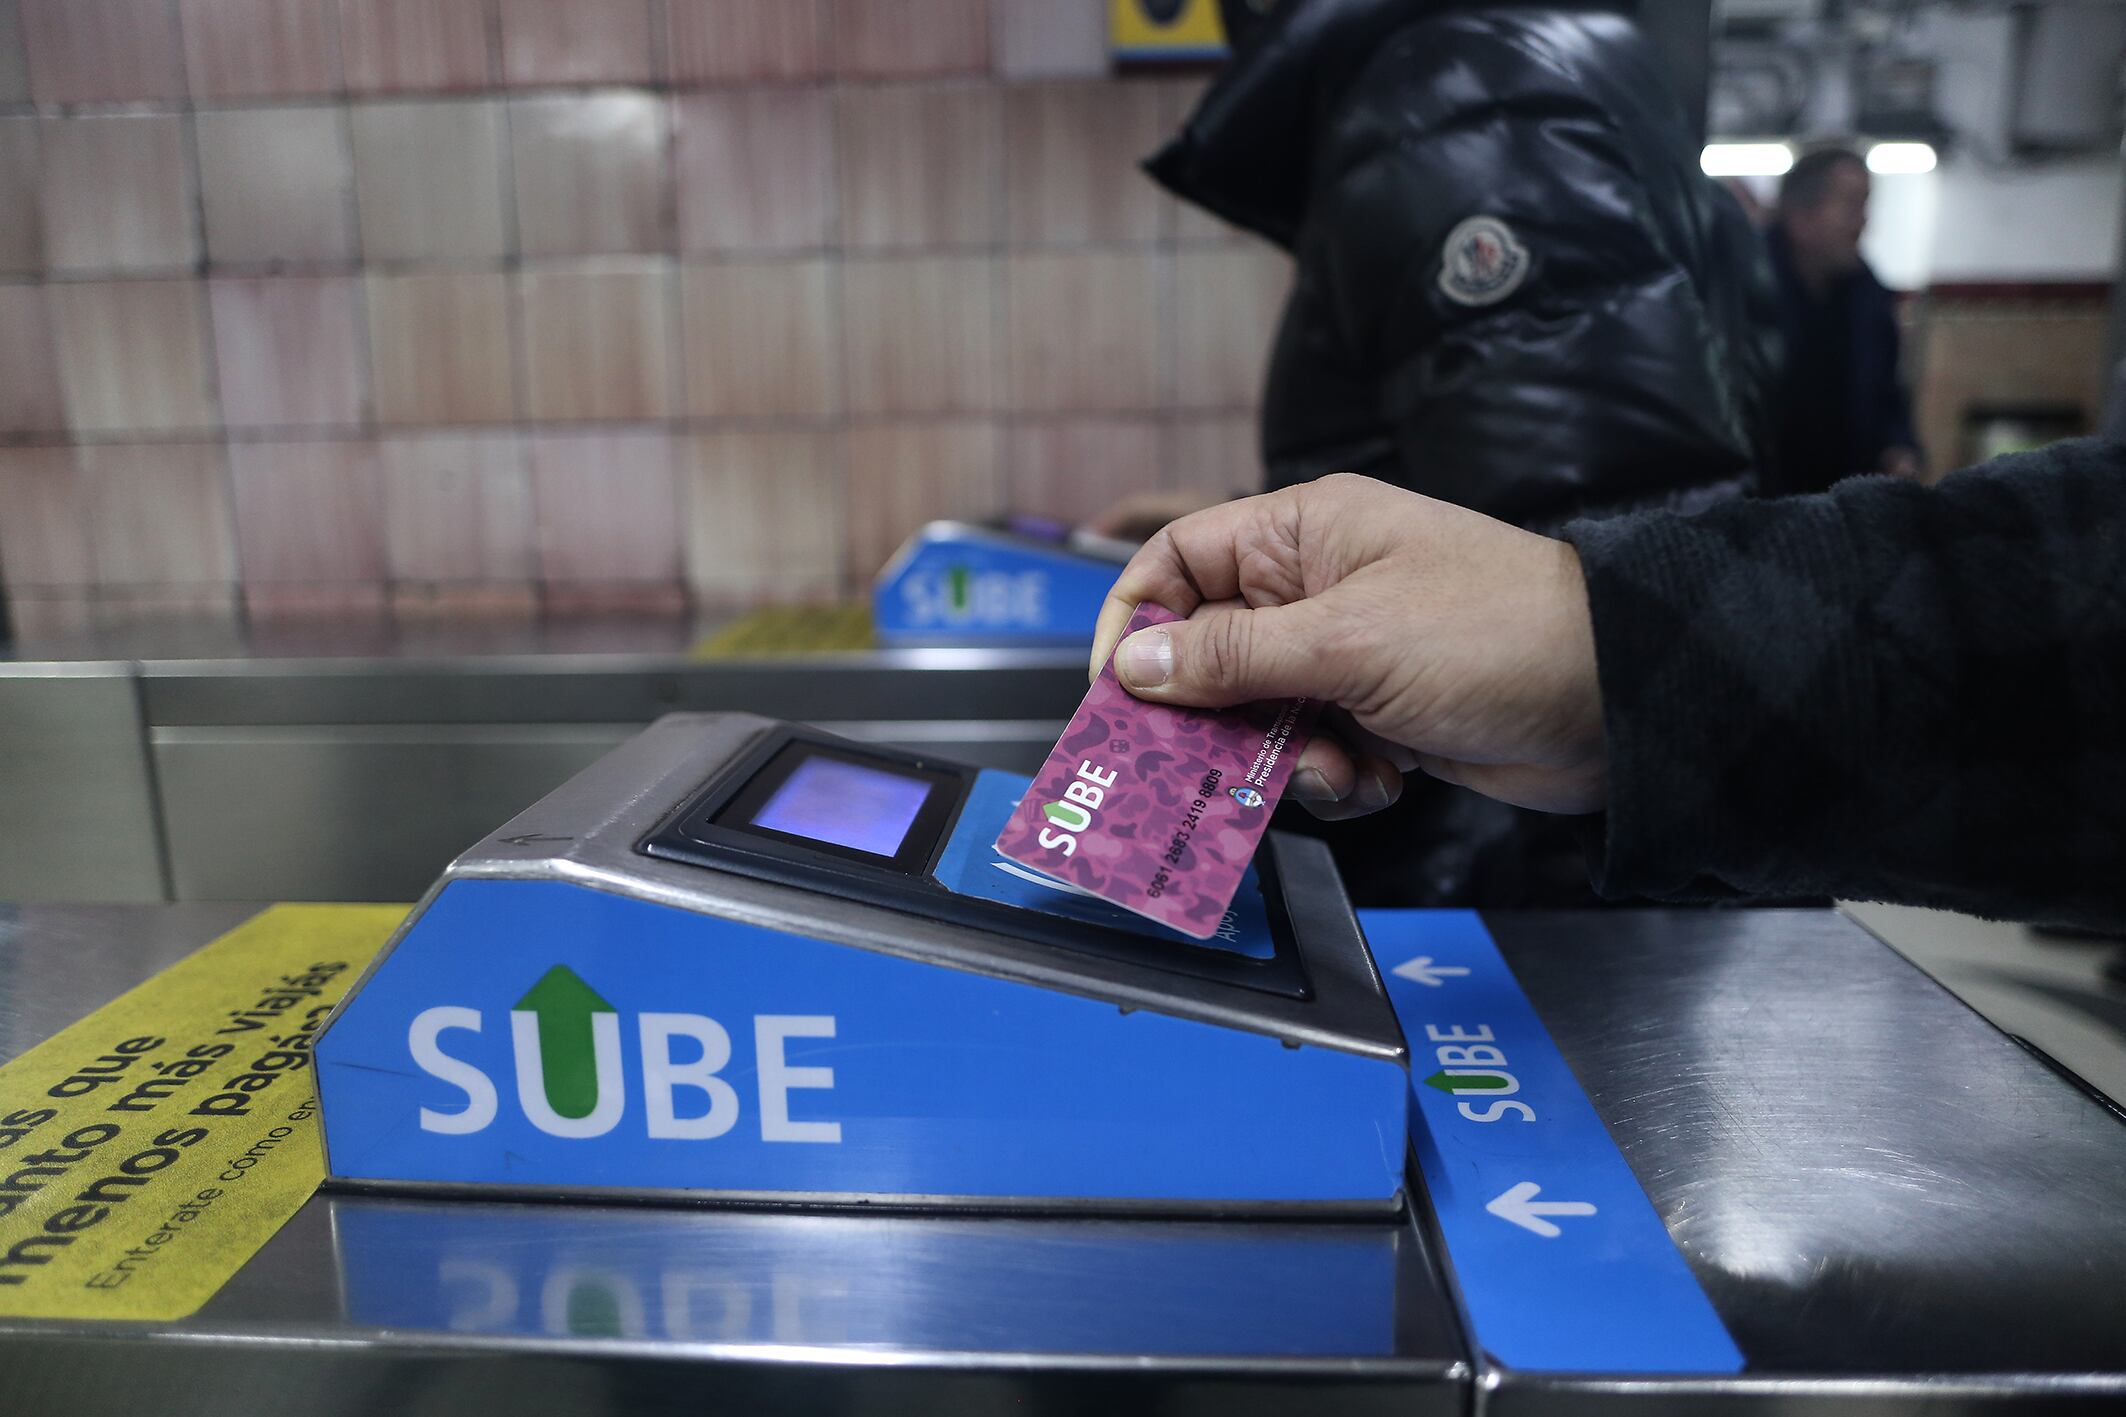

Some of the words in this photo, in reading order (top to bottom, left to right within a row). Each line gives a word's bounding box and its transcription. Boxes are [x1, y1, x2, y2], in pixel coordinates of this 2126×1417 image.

[904, 569, 1047, 626] SUBE
[1244, 748, 1267, 783] Ministerio
[1262, 739, 1272, 750] de
[1254, 736, 1286, 787] Presidencia
[1281, 723, 1292, 736] de
[1038, 759, 1118, 857] SUBE
[1147, 865, 1173, 898] 6061
[1165, 831, 1190, 864] 2683
[1182, 799, 1206, 830] 2419
[1199, 768, 1223, 798] 8809
[47, 1035, 166, 1098] que
[107, 1043, 236, 1112] más
[216, 961, 349, 1035] viajás
[408, 1005, 842, 1144] SUBE
[1425, 1023, 1537, 1123] SUBE
[0, 1127, 209, 1286] menos
[85, 1187, 224, 1290] Enterate
[219, 1126, 292, 1182] cómo
